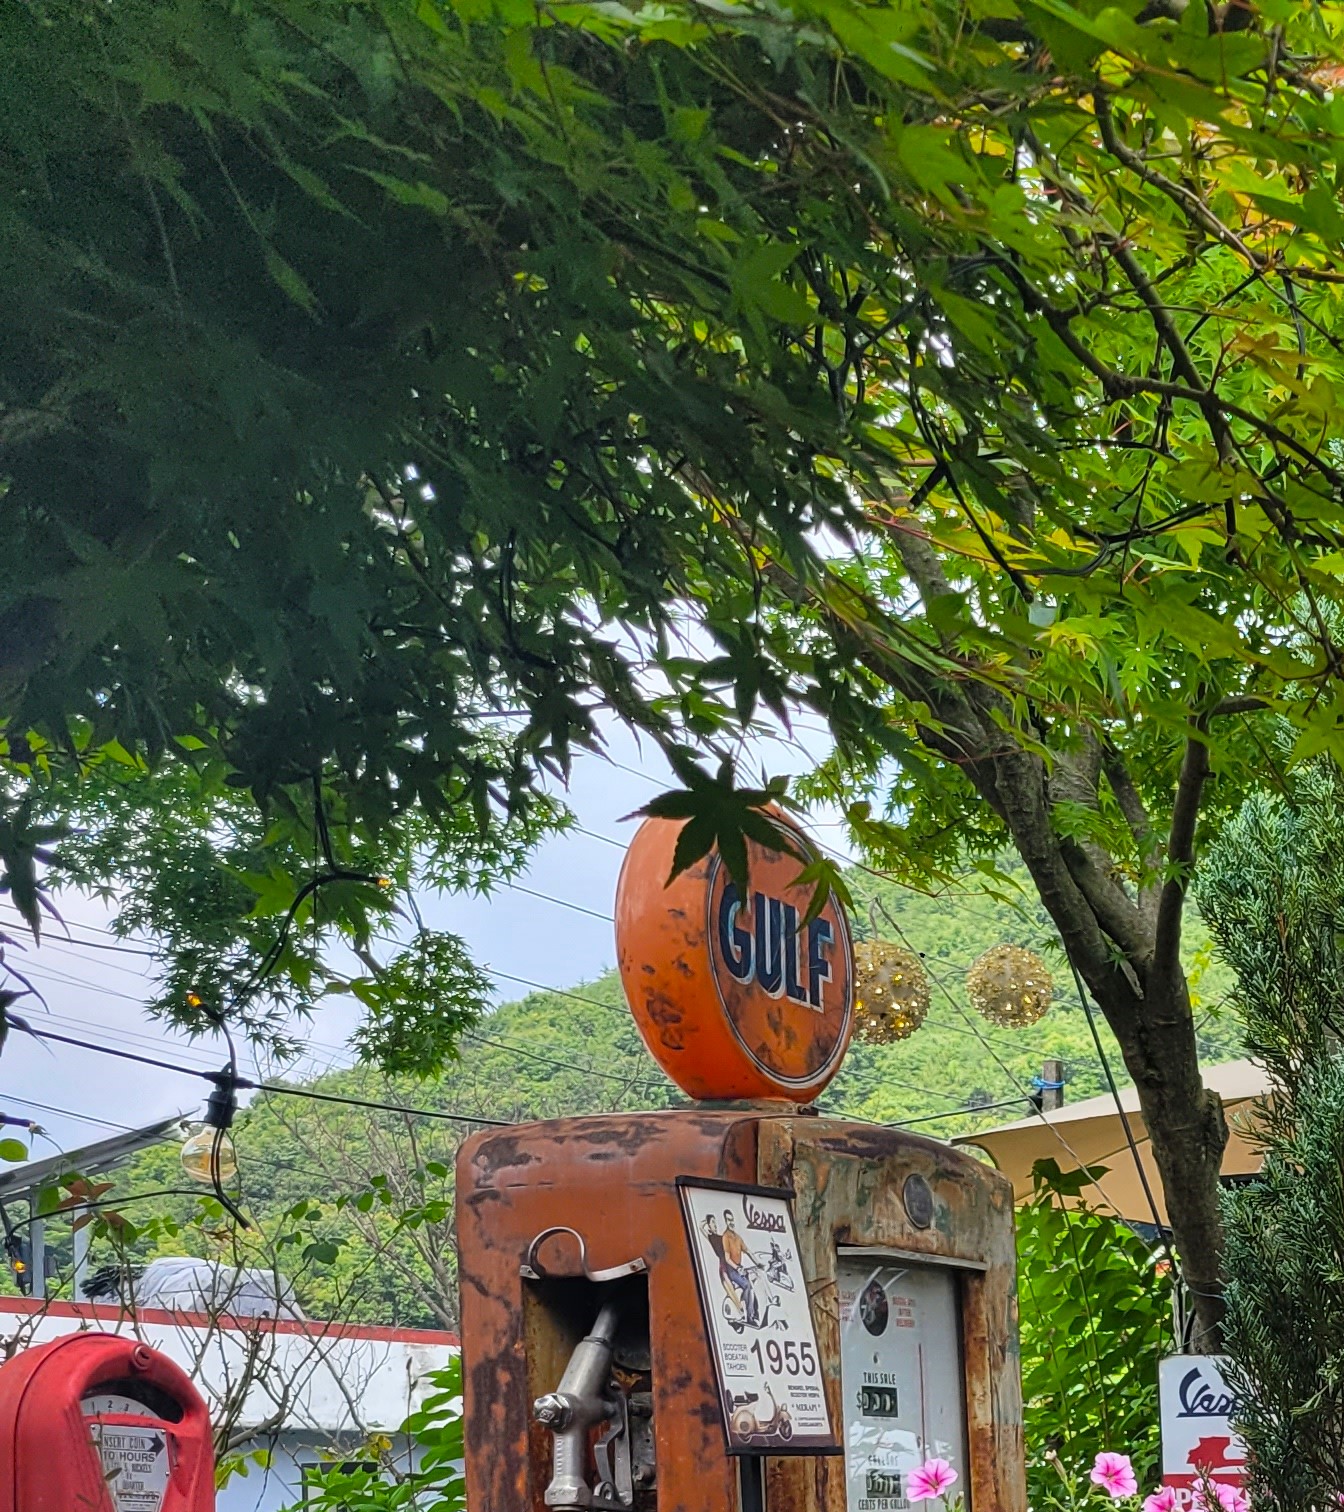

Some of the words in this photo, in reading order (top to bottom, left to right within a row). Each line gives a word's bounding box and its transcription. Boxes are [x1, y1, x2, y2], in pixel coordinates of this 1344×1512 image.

[718, 881, 835, 1014] GULF
[742, 1193, 787, 1234] Vespa
[751, 1338, 816, 1377] 1955
[863, 1371, 879, 1384] THIS
[880, 1372, 896, 1385] SALE
[103, 1450, 115, 1460] 10
[119, 1451, 156, 1463] HOURS
